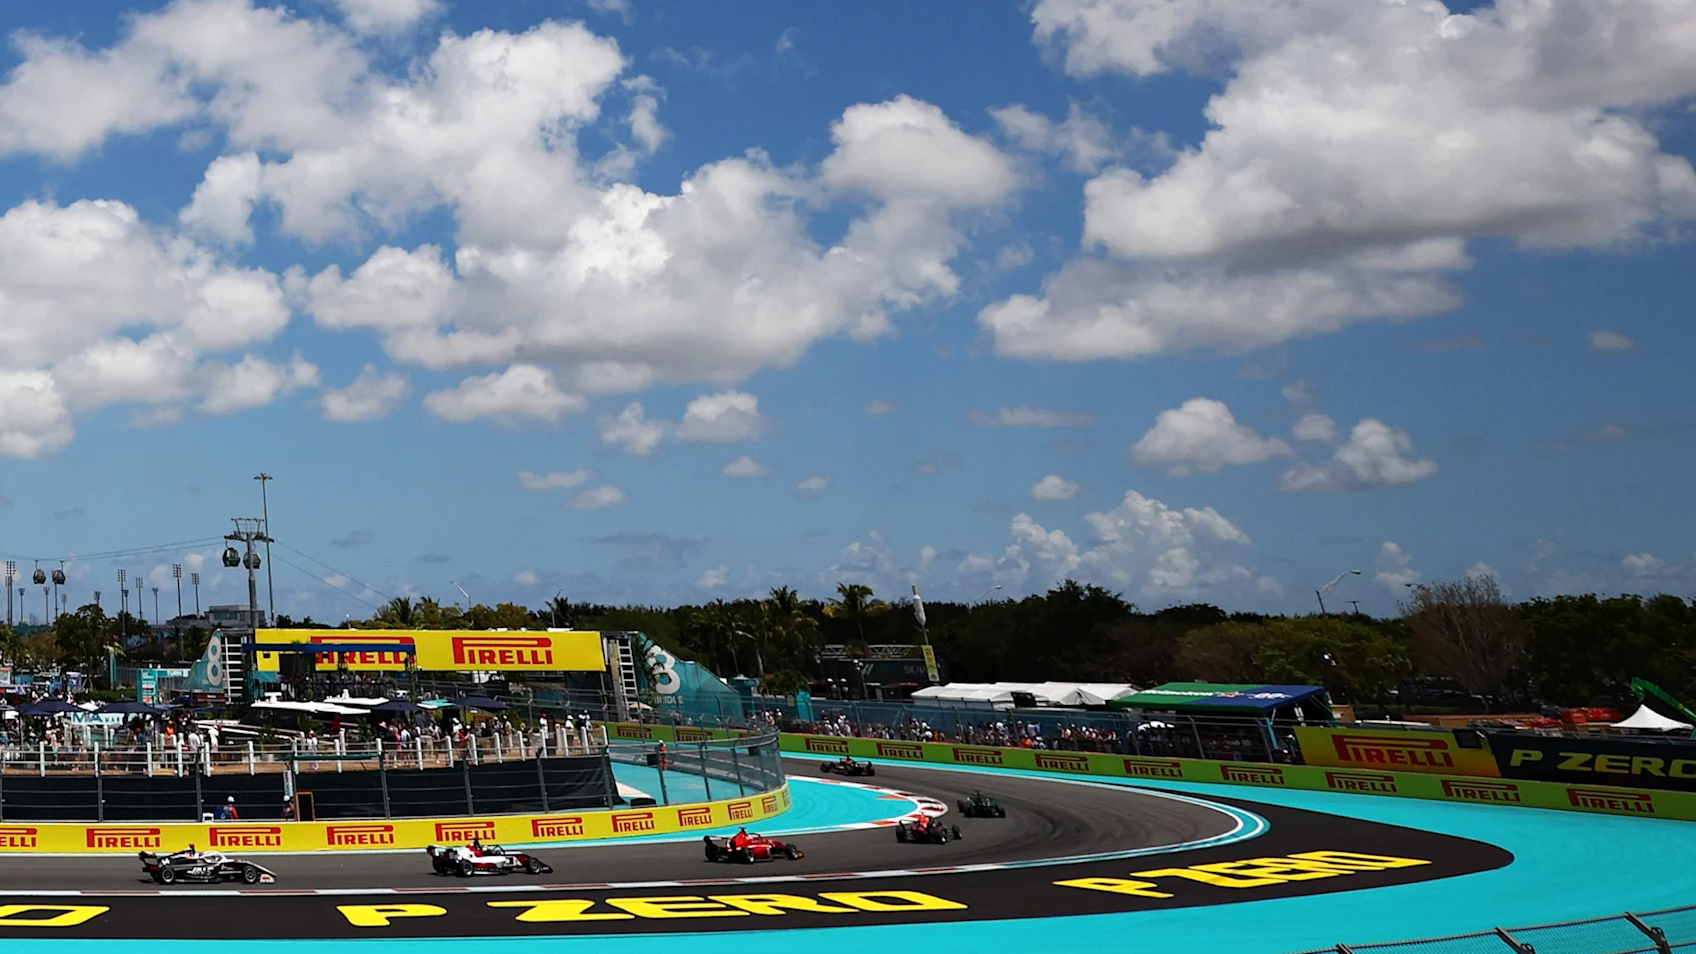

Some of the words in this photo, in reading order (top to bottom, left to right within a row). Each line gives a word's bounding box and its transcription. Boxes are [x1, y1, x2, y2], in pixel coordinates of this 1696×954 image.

[451, 637, 553, 665] PIRELLI
[206, 636, 223, 687] 8
[805, 738, 850, 754] PIRELLI
[877, 743, 924, 759] PIRELLI
[1331, 734, 1455, 768] PIRELLI
[953, 748, 1003, 765] PIRELLI
[1034, 753, 1091, 771] PIRELLI
[1510, 749, 1543, 767] P
[1556, 751, 1696, 778] ZERO
[1123, 759, 1183, 778] PIRELLI
[1220, 765, 1285, 784] PIRELLI
[1325, 771, 1398, 793] PIRELLI
[1441, 779, 1522, 803] PIRELLI
[728, 802, 753, 820] PIRELLI
[1566, 788, 1656, 814] PIRELLI
[612, 812, 655, 833] PIRELLI
[678, 807, 712, 826] PIRELLI
[209, 827, 281, 847] PIRELLI
[326, 825, 395, 845] PIRELLI
[435, 821, 496, 842] PIRELLI
[532, 817, 584, 837] PIRELLI
[86, 828, 161, 848] PIRELLI
[1052, 877, 1175, 898] P
[1129, 851, 1432, 888] ZERO
[336, 904, 447, 926] P
[486, 890, 969, 922] ZERO
